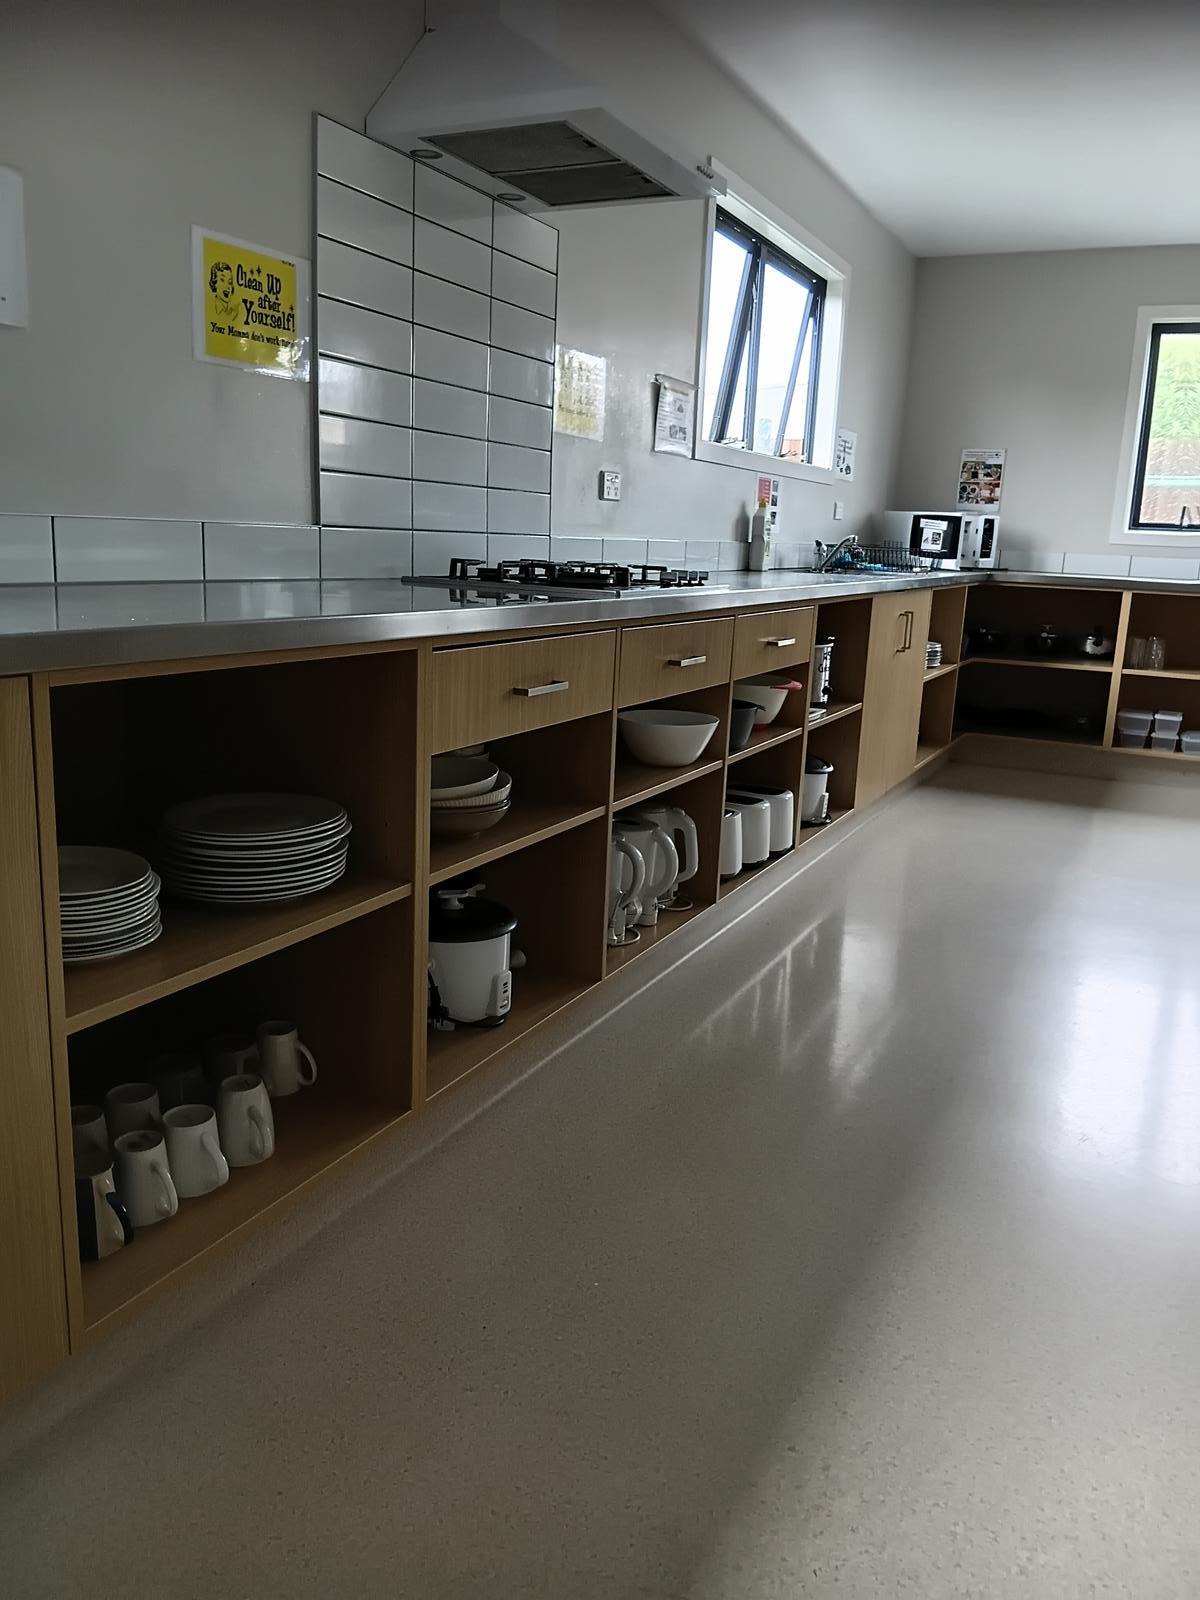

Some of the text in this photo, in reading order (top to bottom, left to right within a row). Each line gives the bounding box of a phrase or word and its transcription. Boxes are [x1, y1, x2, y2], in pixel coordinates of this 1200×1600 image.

[236, 263, 282, 301] Clean Up
[242, 298, 295, 333] Yourself!
[257, 294, 281, 313] after
[210, 321, 225, 335] Your
[266, 335, 280, 346] work
